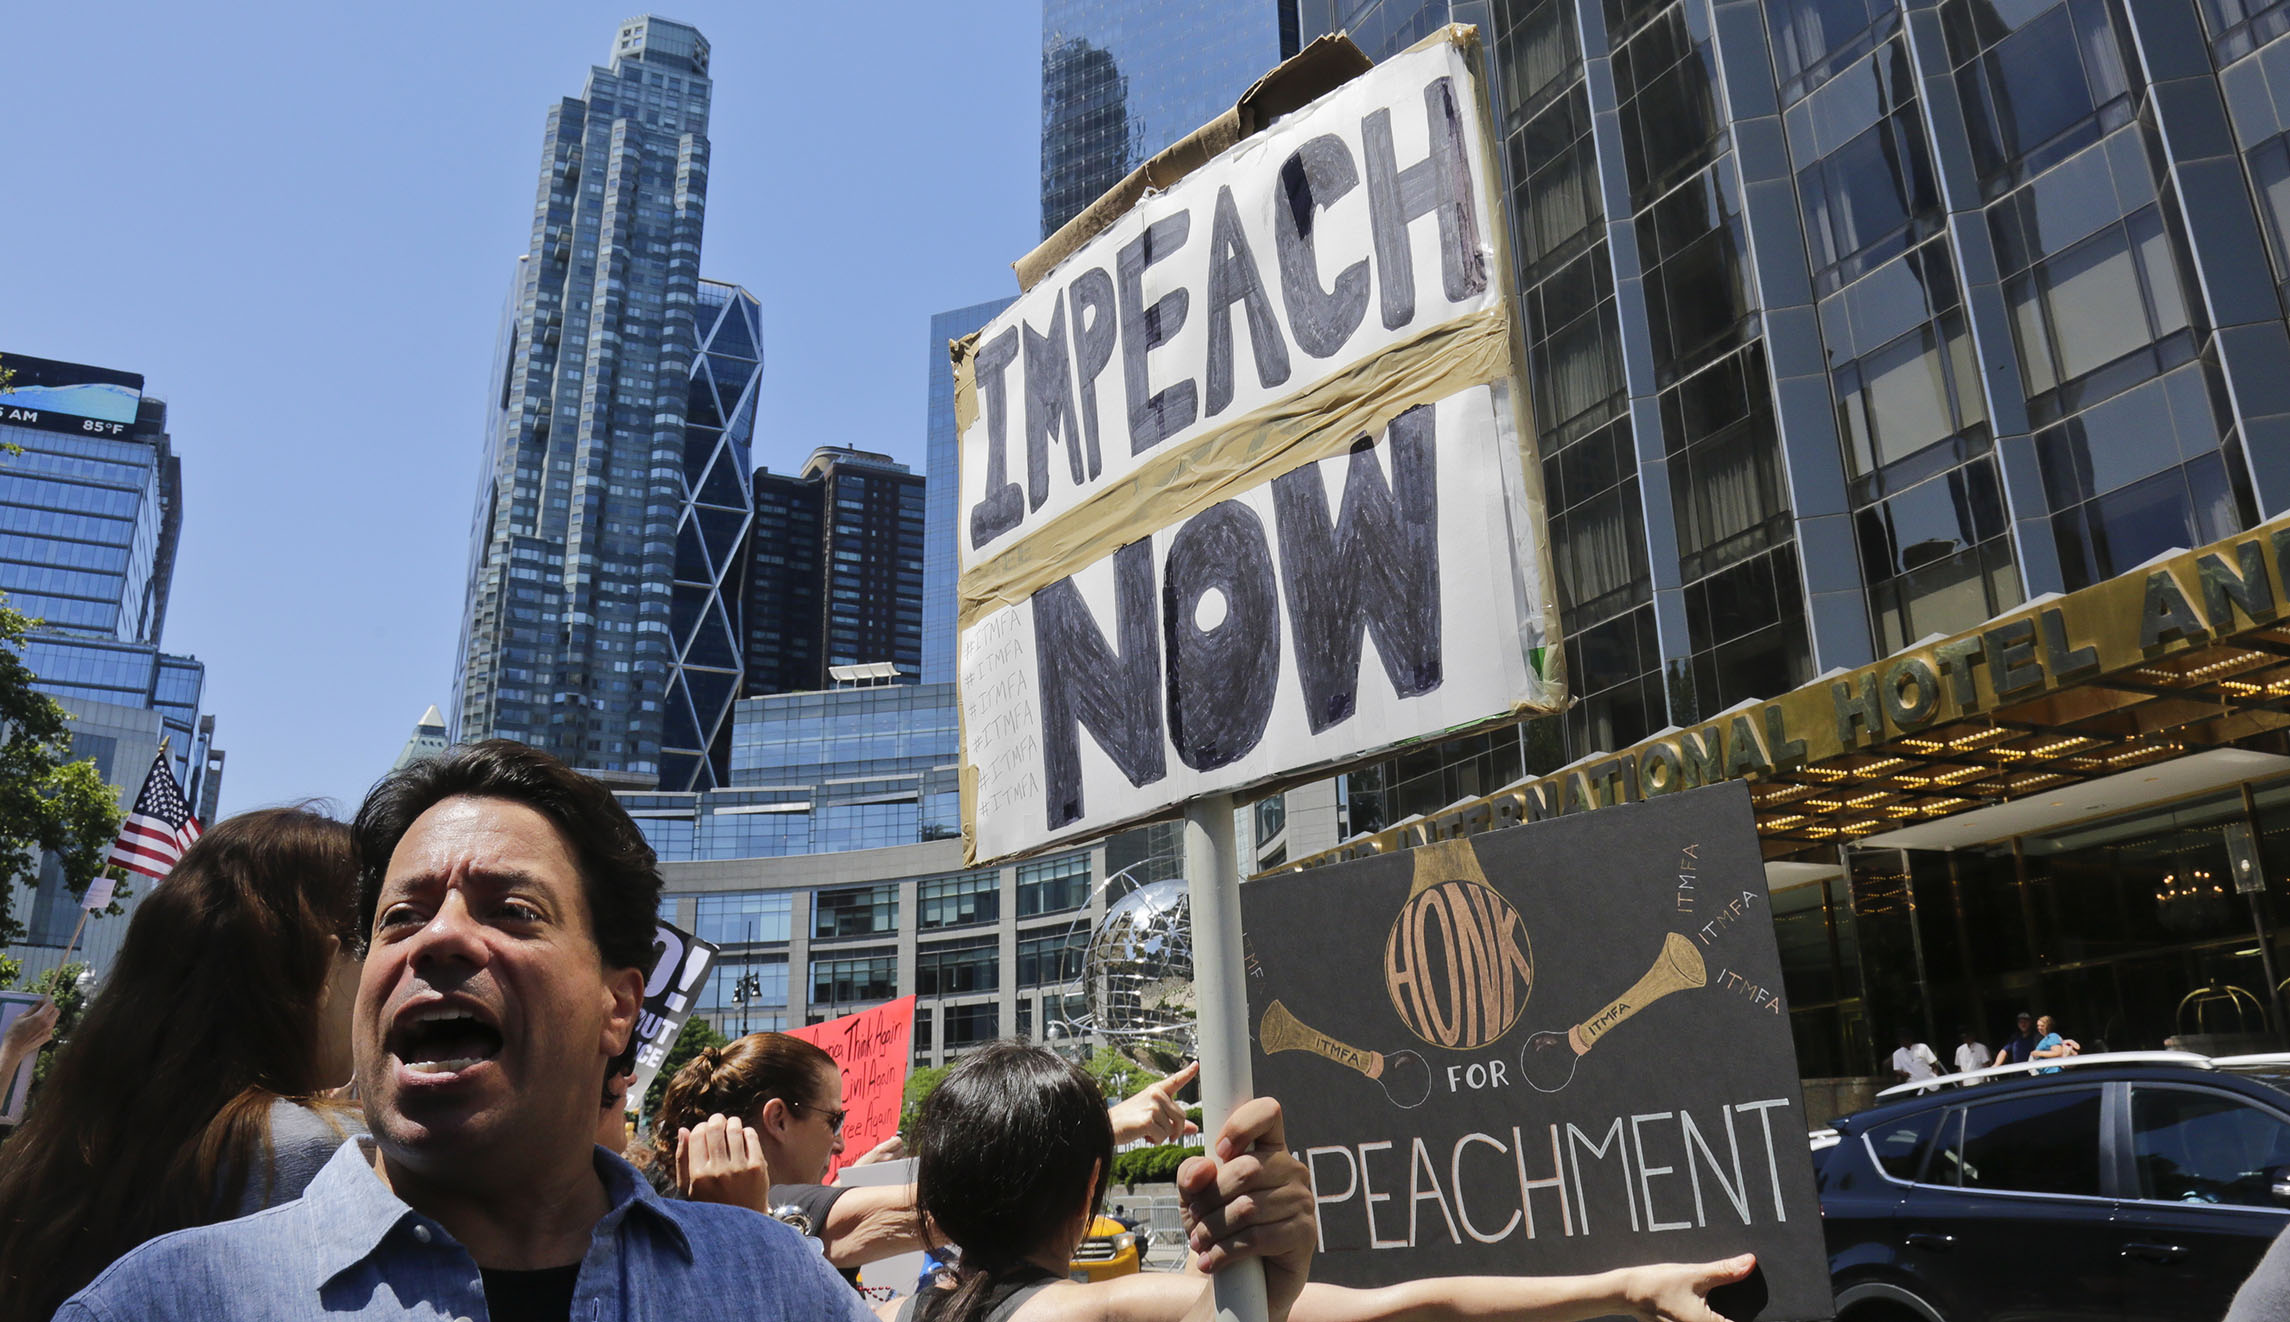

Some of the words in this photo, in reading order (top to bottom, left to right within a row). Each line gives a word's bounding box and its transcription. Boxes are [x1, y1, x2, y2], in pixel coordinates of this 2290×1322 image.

[970, 76, 1487, 551] IMPEACH
[9, 409, 38, 423] AM
[83, 419, 124, 435] 85°F
[1031, 402, 1444, 832] NOW
[1831, 607, 2098, 745] HOTEL
[1677, 843, 1700, 913] ITMFA
[1698, 890, 1758, 945] ITMFA
[1391, 881, 1531, 1048] HONK
[1716, 968, 1780, 1015] ITMFA
[872, 1010, 903, 1058] Again
[1588, 1002, 1632, 1036] ITMFA
[1315, 1037, 1361, 1067] ITMFA
[866, 1058, 897, 1100] Again
[1446, 1060, 1510, 1093] FOR
[864, 1100, 894, 1138] Again
[1291, 1098, 1789, 1254] PEACHMENT
